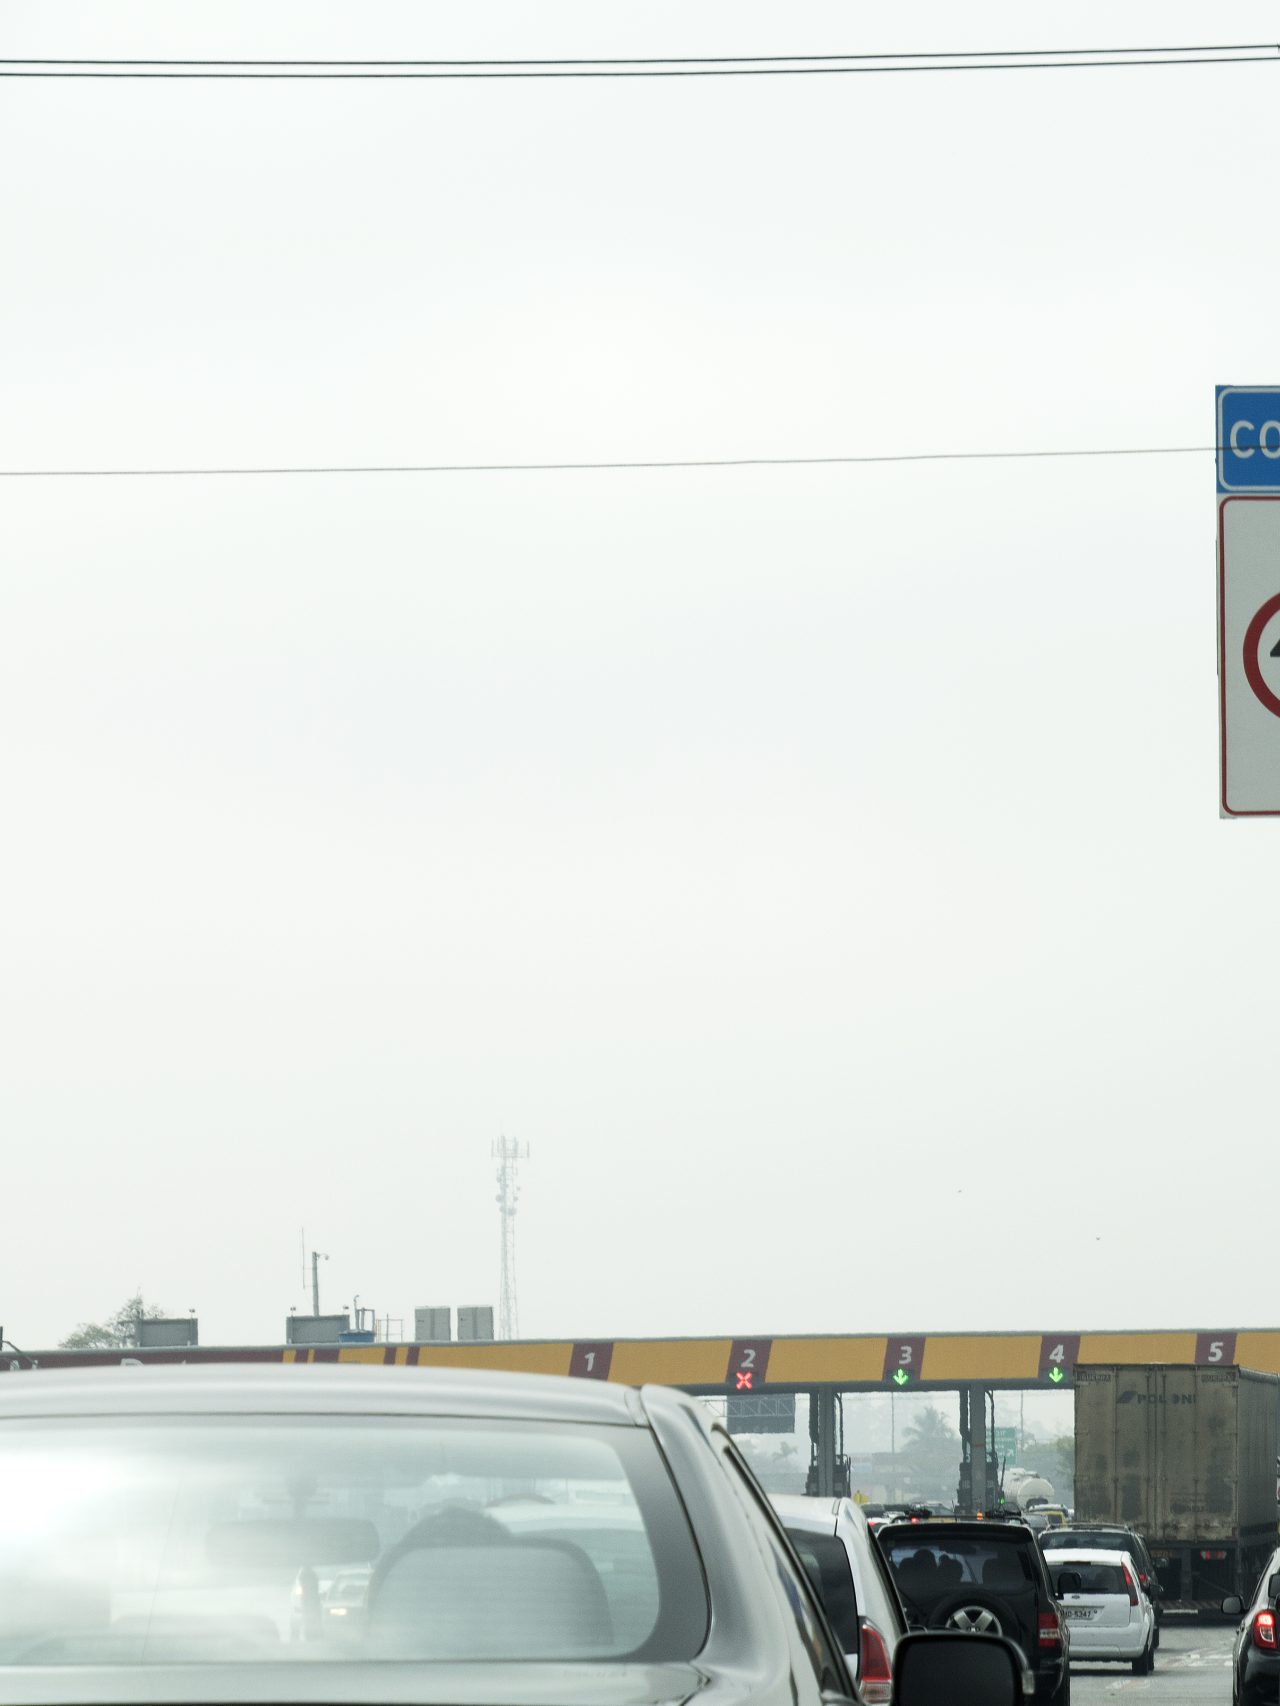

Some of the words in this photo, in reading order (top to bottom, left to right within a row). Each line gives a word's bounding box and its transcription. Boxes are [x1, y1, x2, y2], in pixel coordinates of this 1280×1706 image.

[741, 1349, 756, 1368] 2
[899, 1346, 912, 1364] 3
[1050, 1344, 1064, 1363] 4
[1208, 1342, 1223, 1362] 5
[585, 1352, 595, 1372] 1
